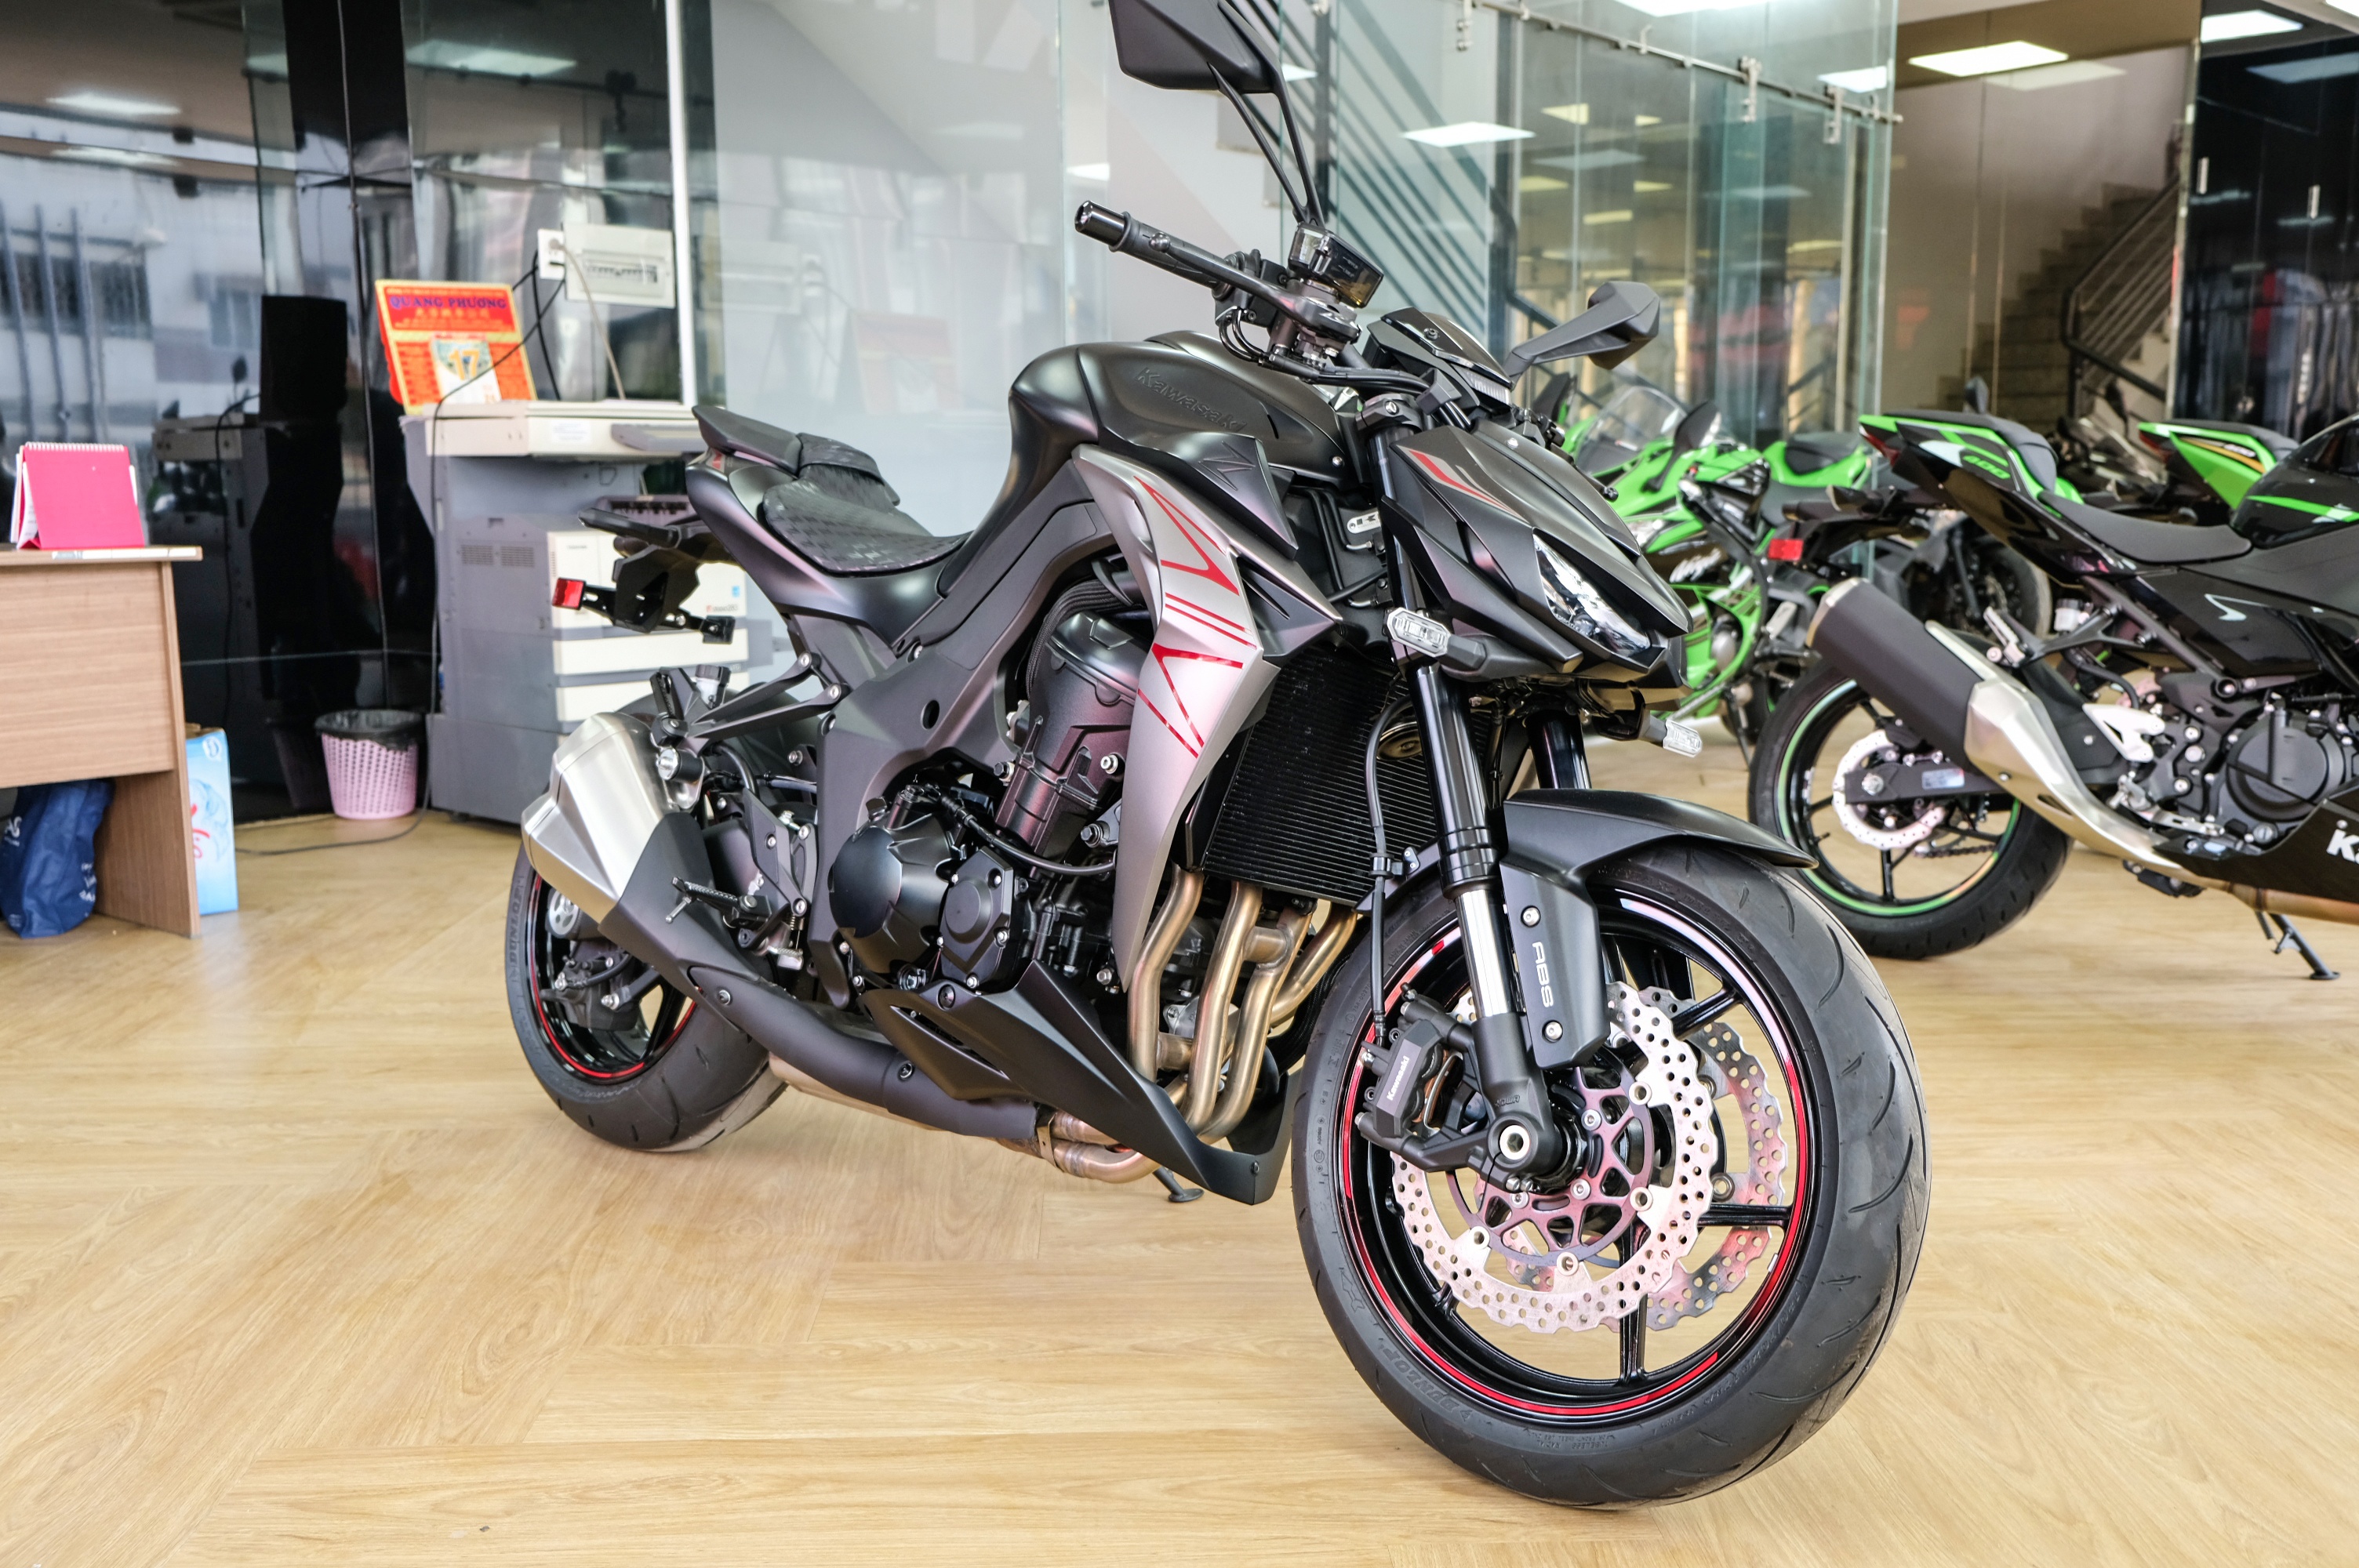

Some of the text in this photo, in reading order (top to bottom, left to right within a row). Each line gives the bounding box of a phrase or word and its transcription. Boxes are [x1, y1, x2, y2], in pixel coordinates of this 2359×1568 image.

[391, 296, 443, 310] QUANG
[449, 350, 480, 380] 17
[1137, 367, 1247, 431] Kawasaki
[1962, 456, 2011, 479] 400
[2326, 829, 2359, 865] K
[509, 887, 524, 965] DUNLOP
[1532, 941, 1554, 1008] ABS
[1387, 1055, 1410, 1102] Kawasaki
[1382, 1347, 1459, 1411] DUNLOP
